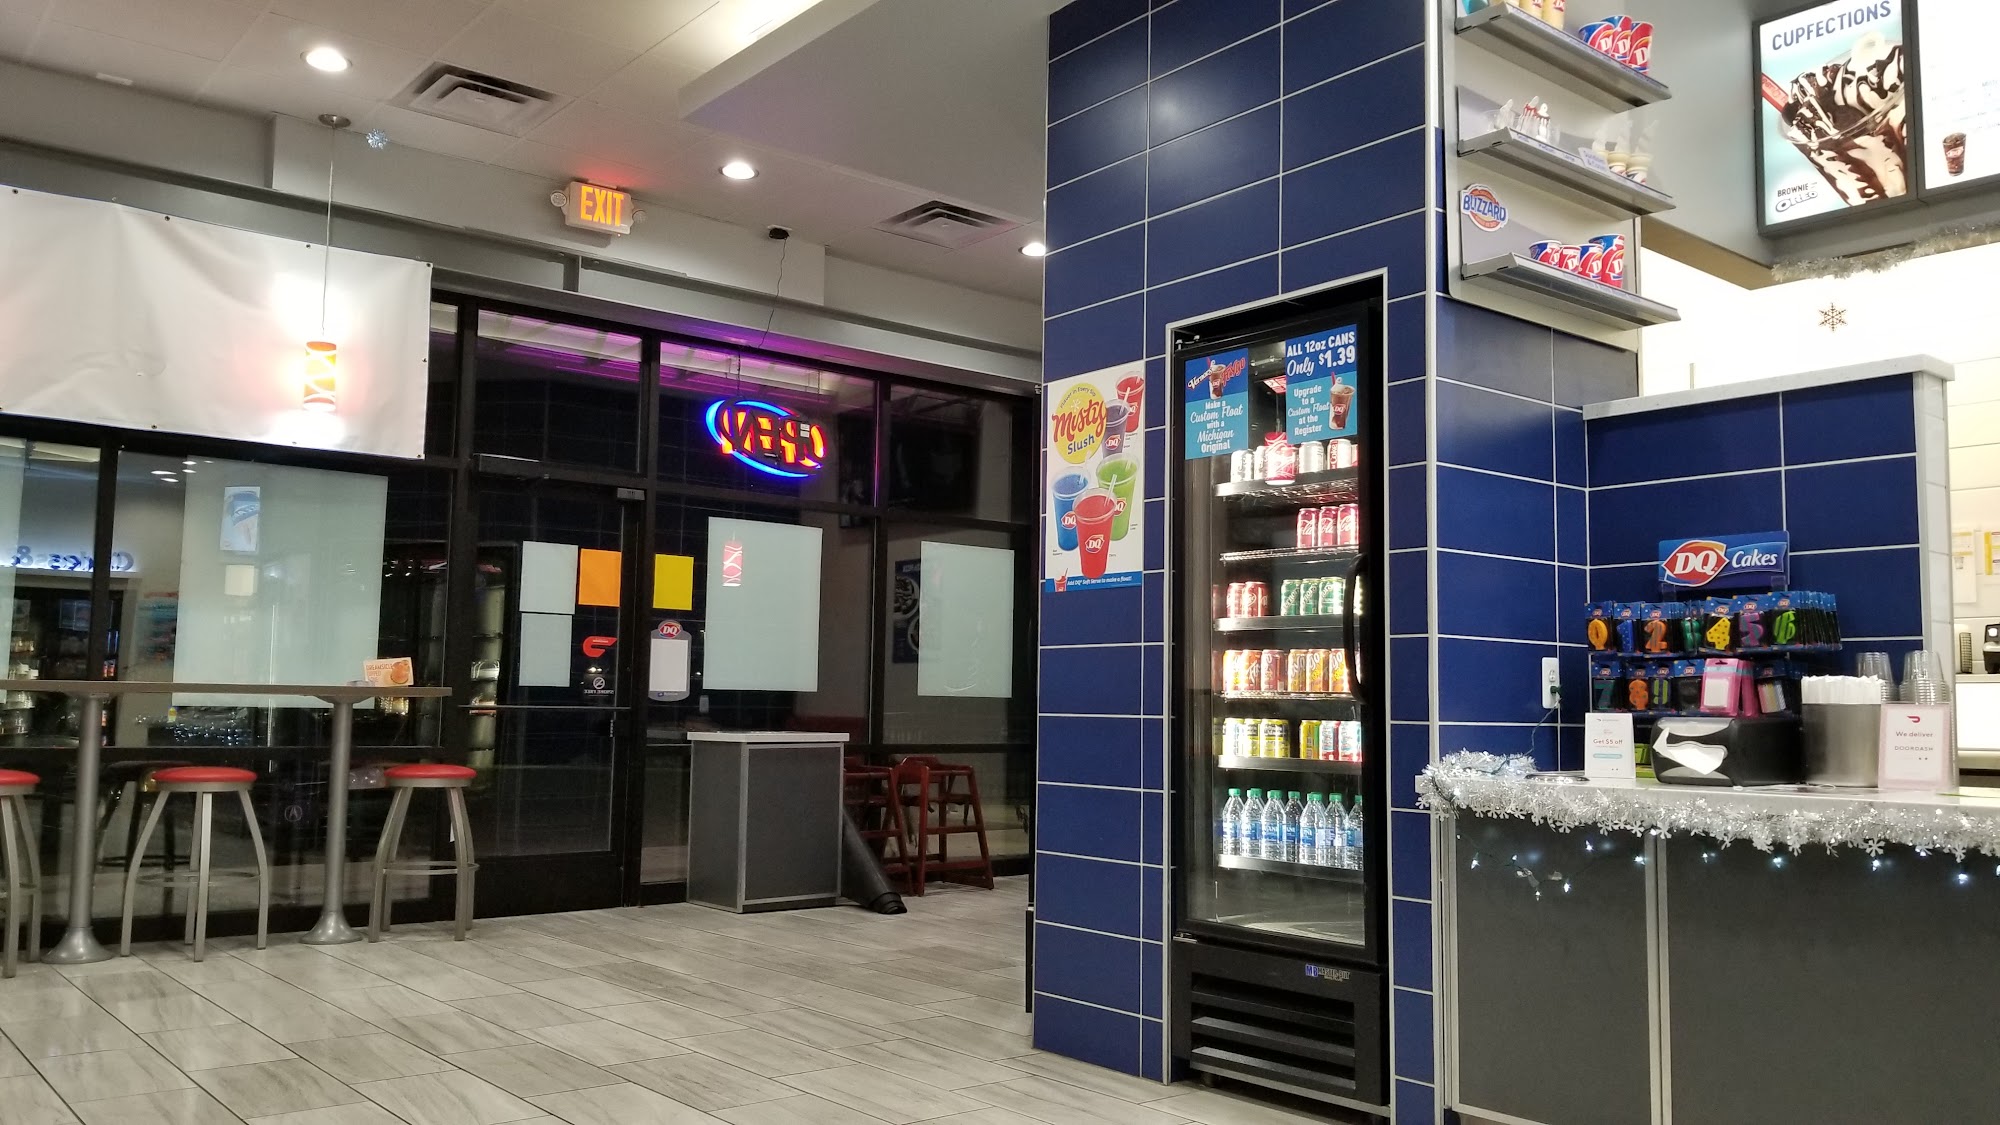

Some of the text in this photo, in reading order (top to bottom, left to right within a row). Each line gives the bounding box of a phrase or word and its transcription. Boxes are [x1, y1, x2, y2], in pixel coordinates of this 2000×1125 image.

[1771, 1, 1892, 51] CUPFECTIONS
[1777, 183, 1809, 197] BROWNIE
[580, 185, 624, 227] EXIT
[1463, 195, 1506, 221] BLIZZARD
[1775, 190, 1818, 213] OREO
[1287, 331, 1356, 358] ALL 12oz CANS
[1287, 345, 1356, 377] Only $1.39
[1293, 385, 1322, 398] Upgrade
[1190, 405, 1243, 423] Custom Float
[1205, 400, 1221, 410] Make
[1287, 401, 1331, 417] Custom Float
[1052, 399, 1107, 442] Misty
[1206, 420, 1218, 429] with
[1298, 415, 1319, 425] at the
[1197, 429, 1235, 445] Michigan
[1294, 423, 1323, 436] Register
[1067, 434, 1096, 455] Slush
[1107, 438, 1119, 447] DQ
[1200, 441, 1231, 454] Original
[1064, 515, 1077, 526] DQ
[1088, 539, 1102, 550] DQ
[1732, 549, 1778, 568] Cakes
[662, 626, 678, 636] DQ
[1644, 619, 1667, 653] 2
[1706, 617, 1731, 651] 4
[1739, 612, 1764, 647] 5
[1773, 610, 1796, 645] 6
